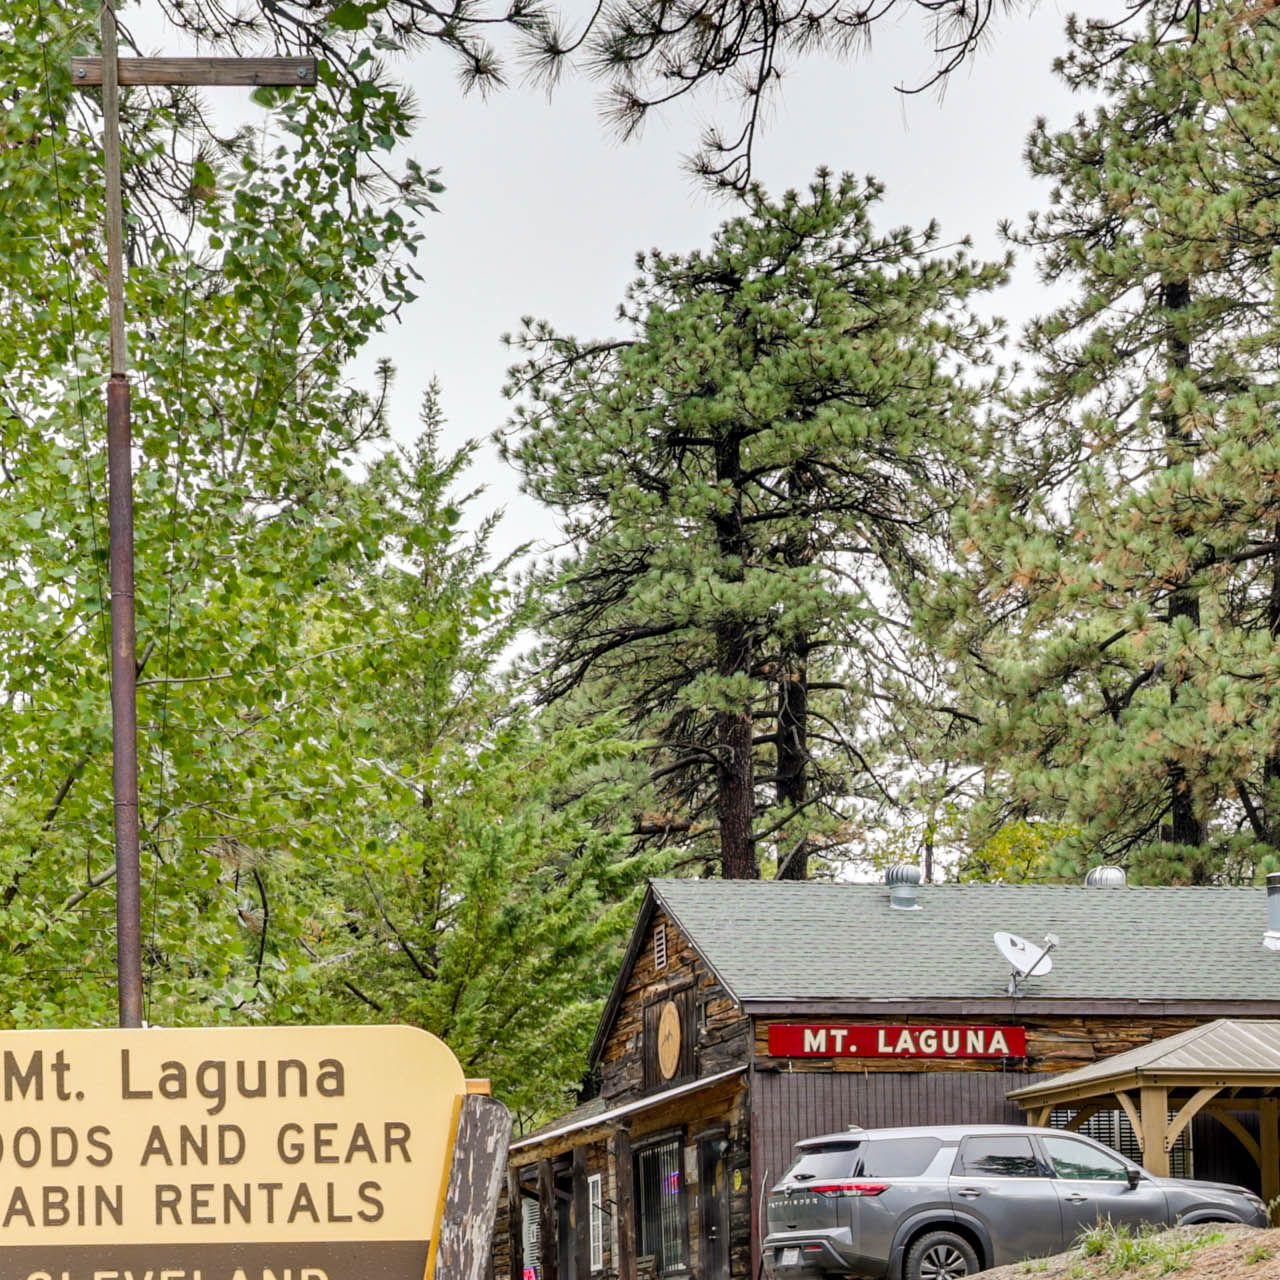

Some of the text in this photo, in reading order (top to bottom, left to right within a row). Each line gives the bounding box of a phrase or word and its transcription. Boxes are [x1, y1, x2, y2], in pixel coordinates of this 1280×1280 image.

[803, 1028, 1010, 1054] MT. LAGUNA
[3, 1048, 345, 1116] Mt. Laguna
[139, 1124, 246, 1167] AND
[277, 1121, 413, 1165] GEAR
[155, 1180, 385, 1226] RENTALS
